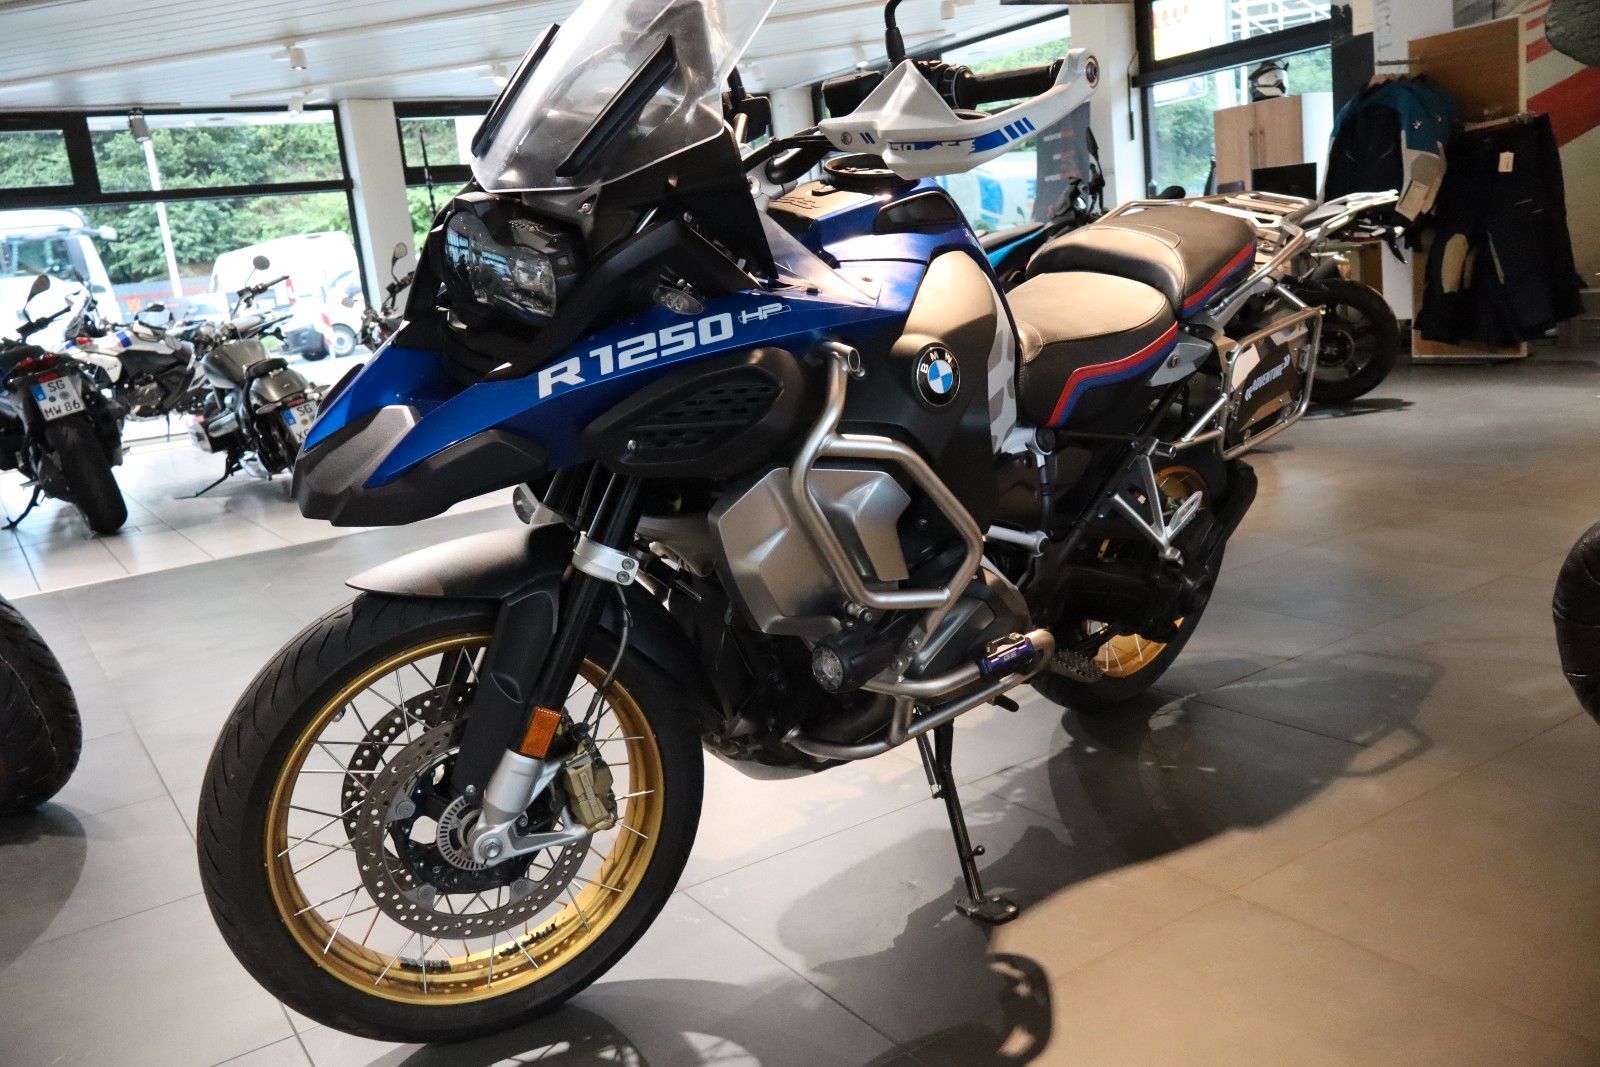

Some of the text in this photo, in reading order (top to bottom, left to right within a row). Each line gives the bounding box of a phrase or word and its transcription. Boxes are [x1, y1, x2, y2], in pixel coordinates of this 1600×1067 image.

[537, 302, 791, 399] R 1250 HP
[920, 350, 953, 374] BMW
[47, 379, 66, 392] SG
[64, 400, 81, 411] 86
[296, 403, 313, 416] SG
